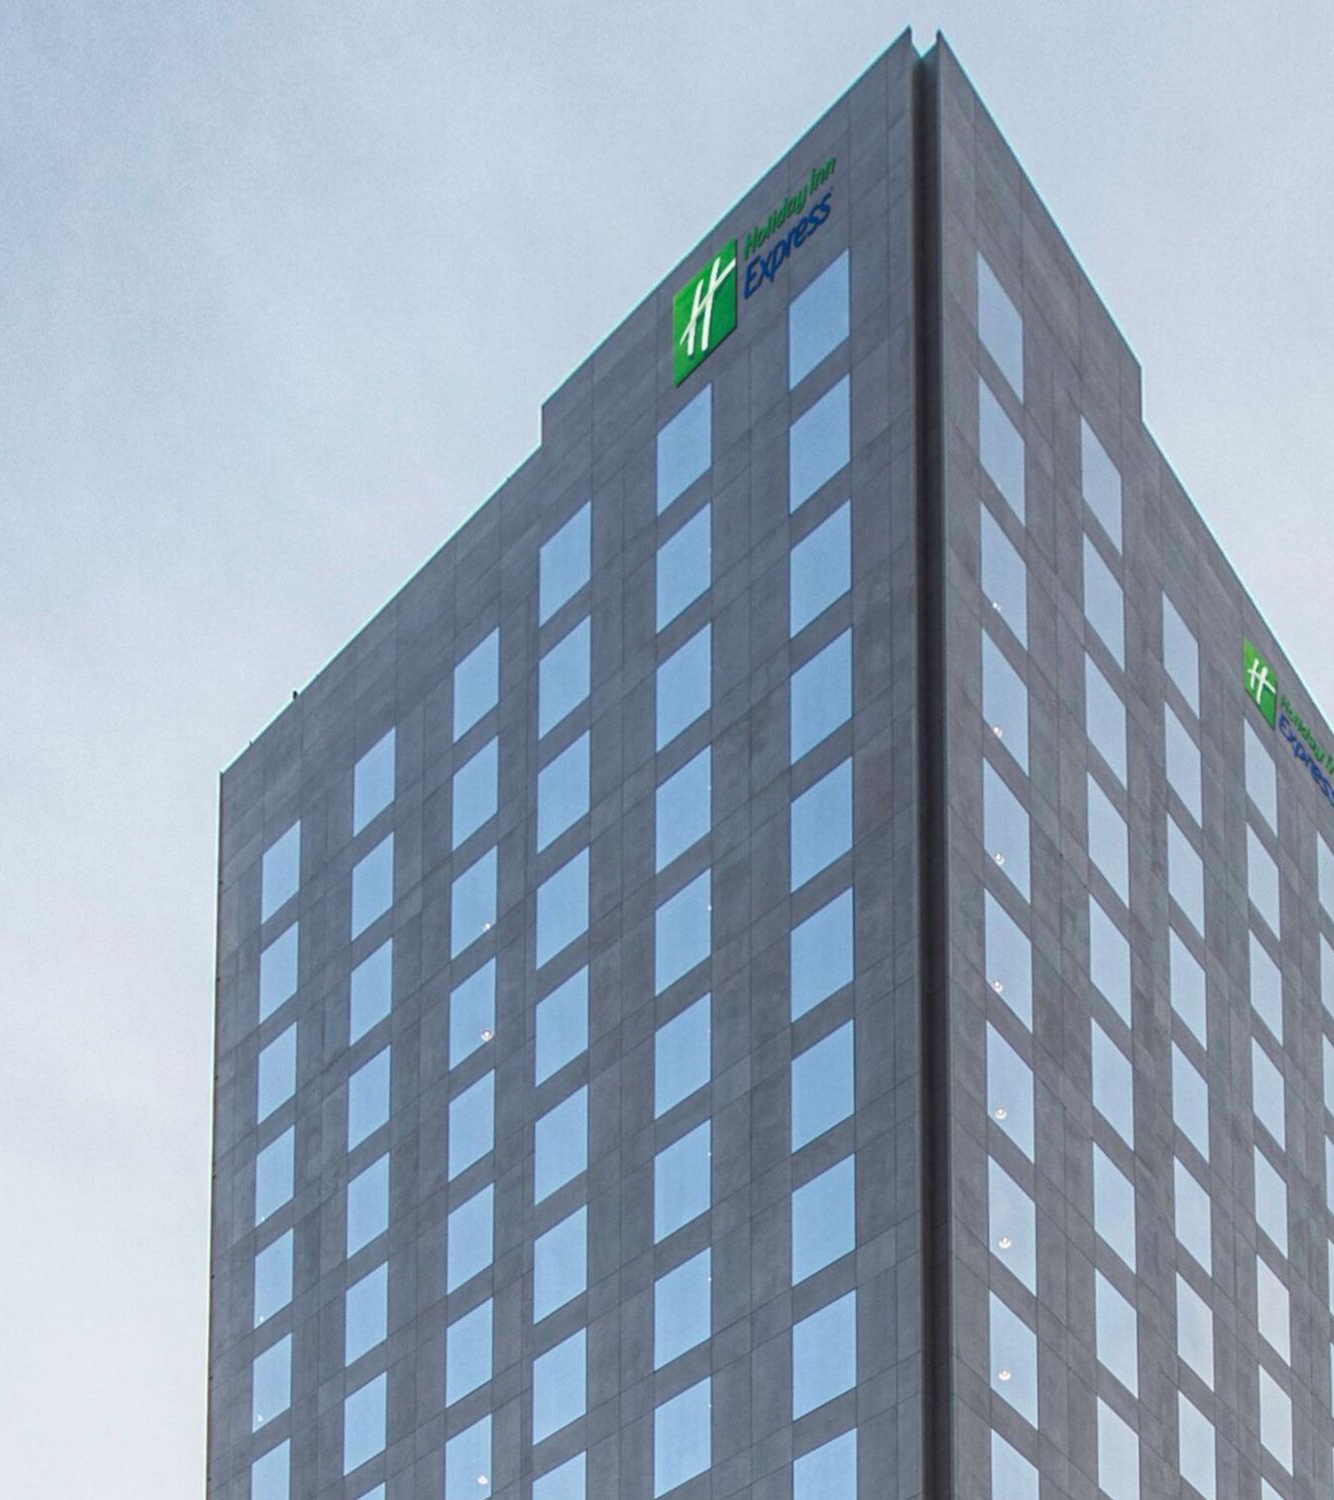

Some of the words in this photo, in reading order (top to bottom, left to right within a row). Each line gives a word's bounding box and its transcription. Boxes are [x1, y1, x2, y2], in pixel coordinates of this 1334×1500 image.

[743, 183, 809, 261] Holiday
[809, 156, 837, 197] Inn
[743, 190, 834, 300] Express
[1278, 694, 1325, 764] Holiday
